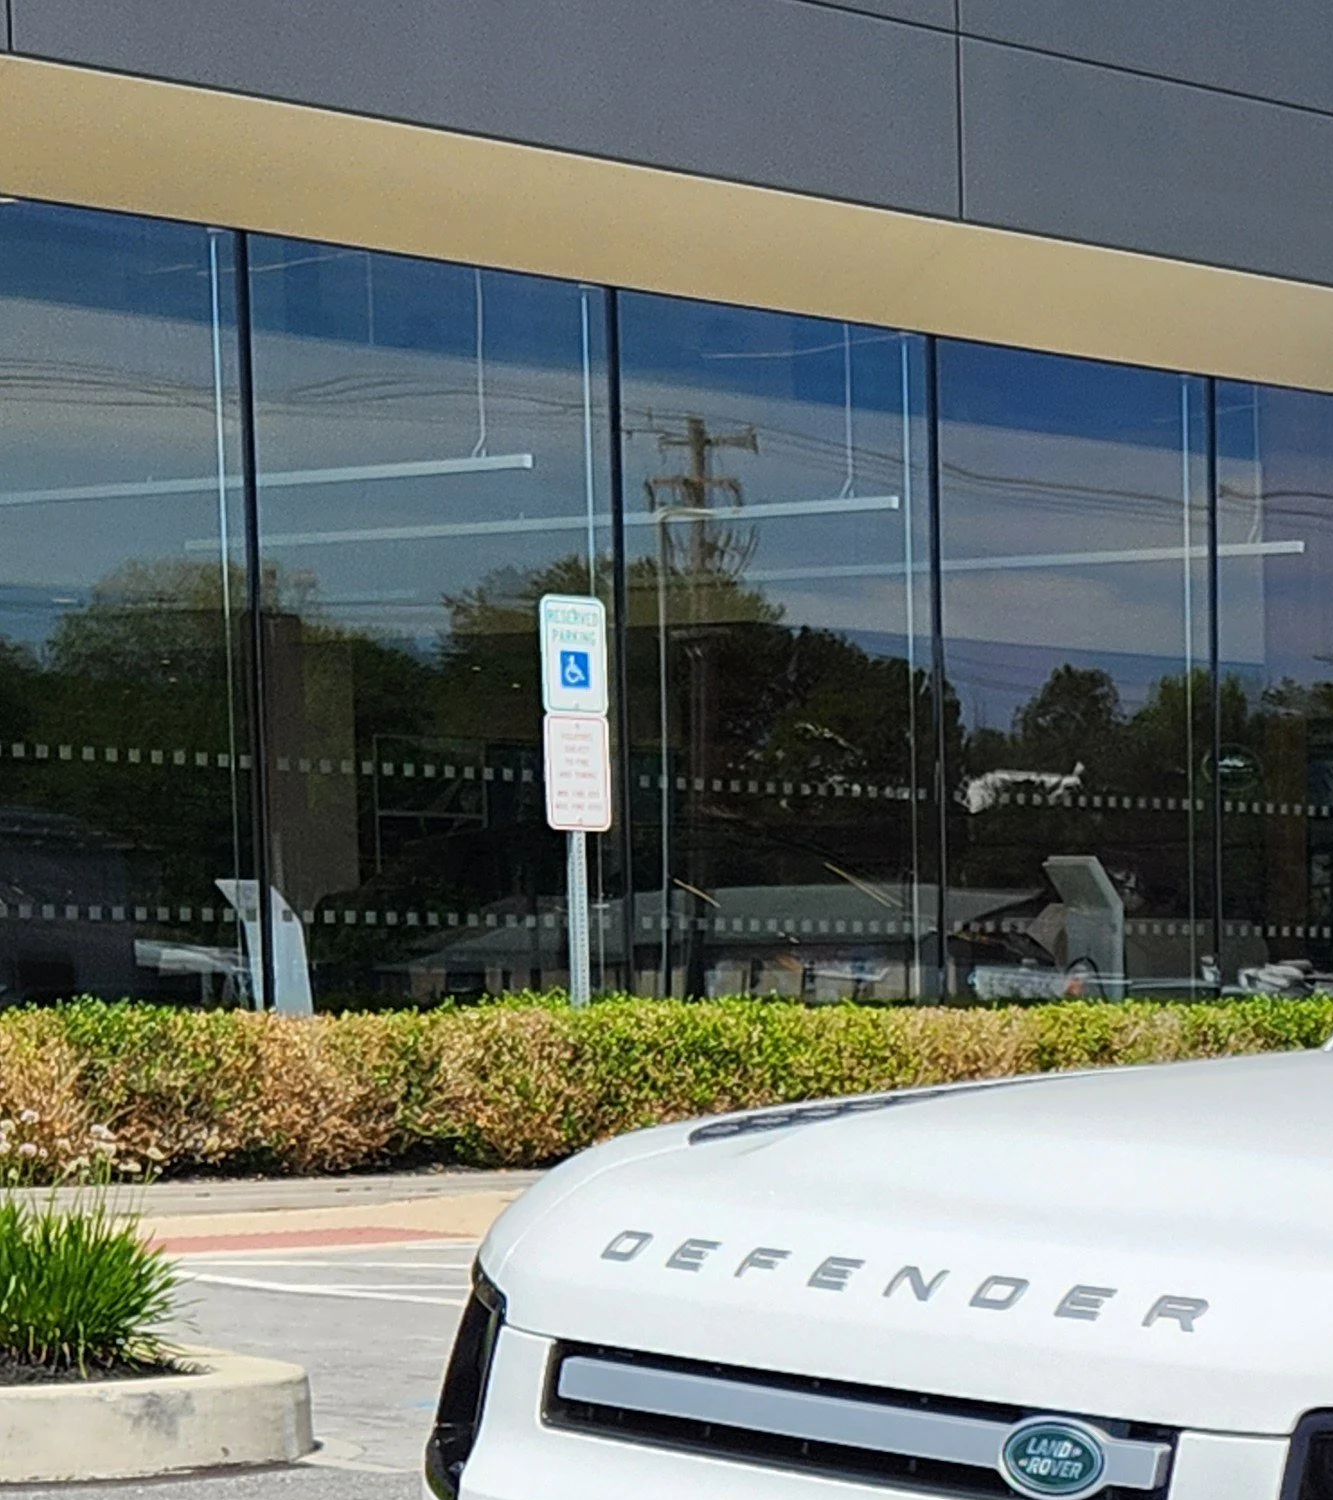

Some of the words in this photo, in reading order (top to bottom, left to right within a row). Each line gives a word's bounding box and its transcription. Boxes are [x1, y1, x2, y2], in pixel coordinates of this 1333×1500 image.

[552, 627, 596, 647] PARKING
[600, 1229, 1210, 1333] DEFENDER
[1026, 1437, 1073, 1458] LAND
[1026, 1456, 1083, 1479] ROVER
